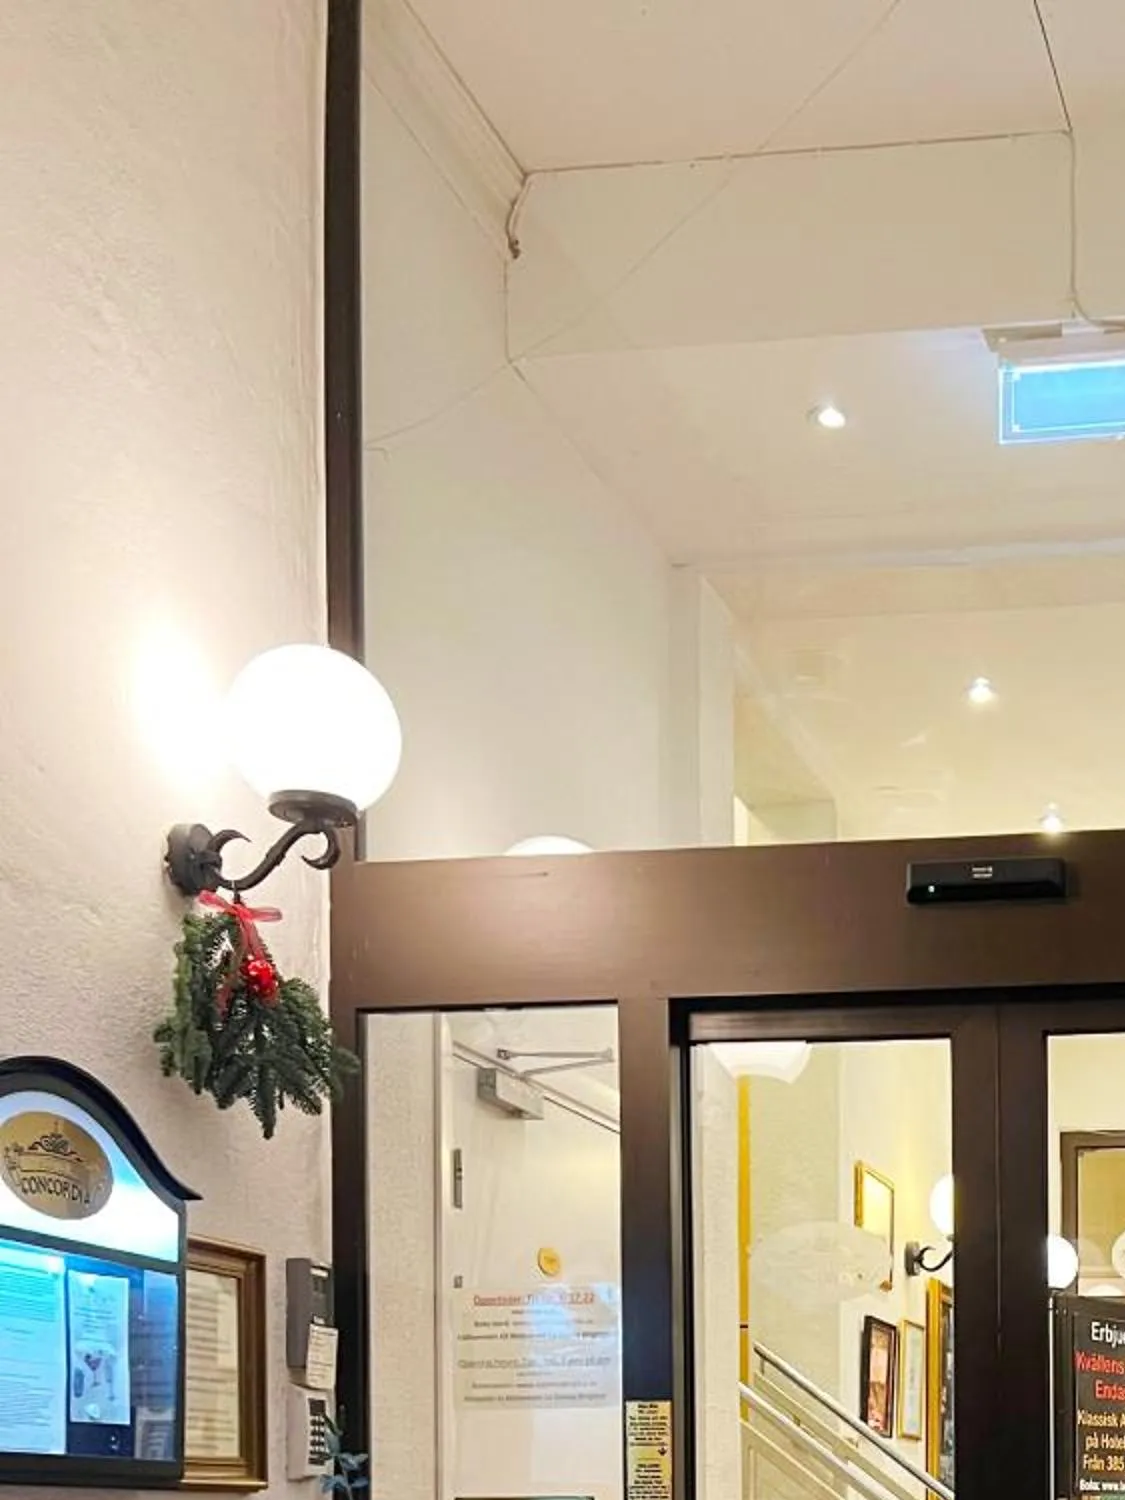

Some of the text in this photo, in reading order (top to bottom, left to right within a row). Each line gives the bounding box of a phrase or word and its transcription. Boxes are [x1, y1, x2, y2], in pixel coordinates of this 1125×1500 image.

[1077, 1409, 1118, 1428] Klassisk
[1085, 1432, 1099, 1452] på
[1083, 1454, 1105, 1471] Från
